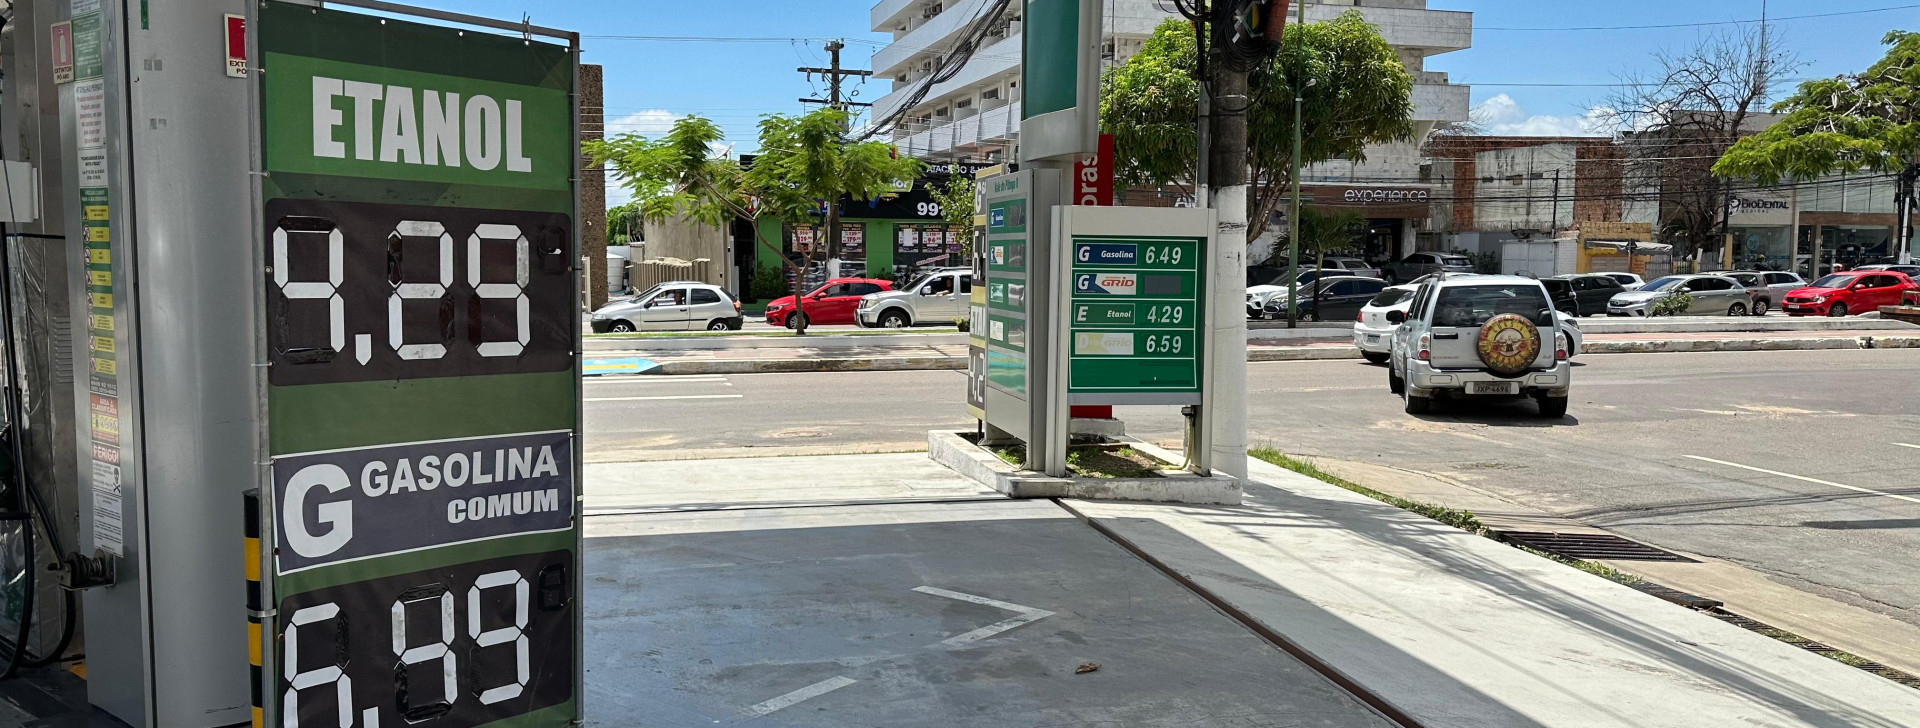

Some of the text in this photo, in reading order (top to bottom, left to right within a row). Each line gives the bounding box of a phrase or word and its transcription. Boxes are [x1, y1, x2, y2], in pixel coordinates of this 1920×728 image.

[54, 66, 72, 74] EXTINTOR
[312, 75, 532, 173] ETANOL
[1344, 189, 1428, 206] experience
[1078, 246, 1182, 265] G Gasolina 6,49
[1077, 274, 1090, 290] G
[1077, 305, 1183, 324] E Etanol 4,29
[1077, 335, 1089, 349] D
[1146, 335, 1182, 354] 6,59
[283, 445, 559, 558] G GASOLINA
[447, 488, 559, 524] COMUM
